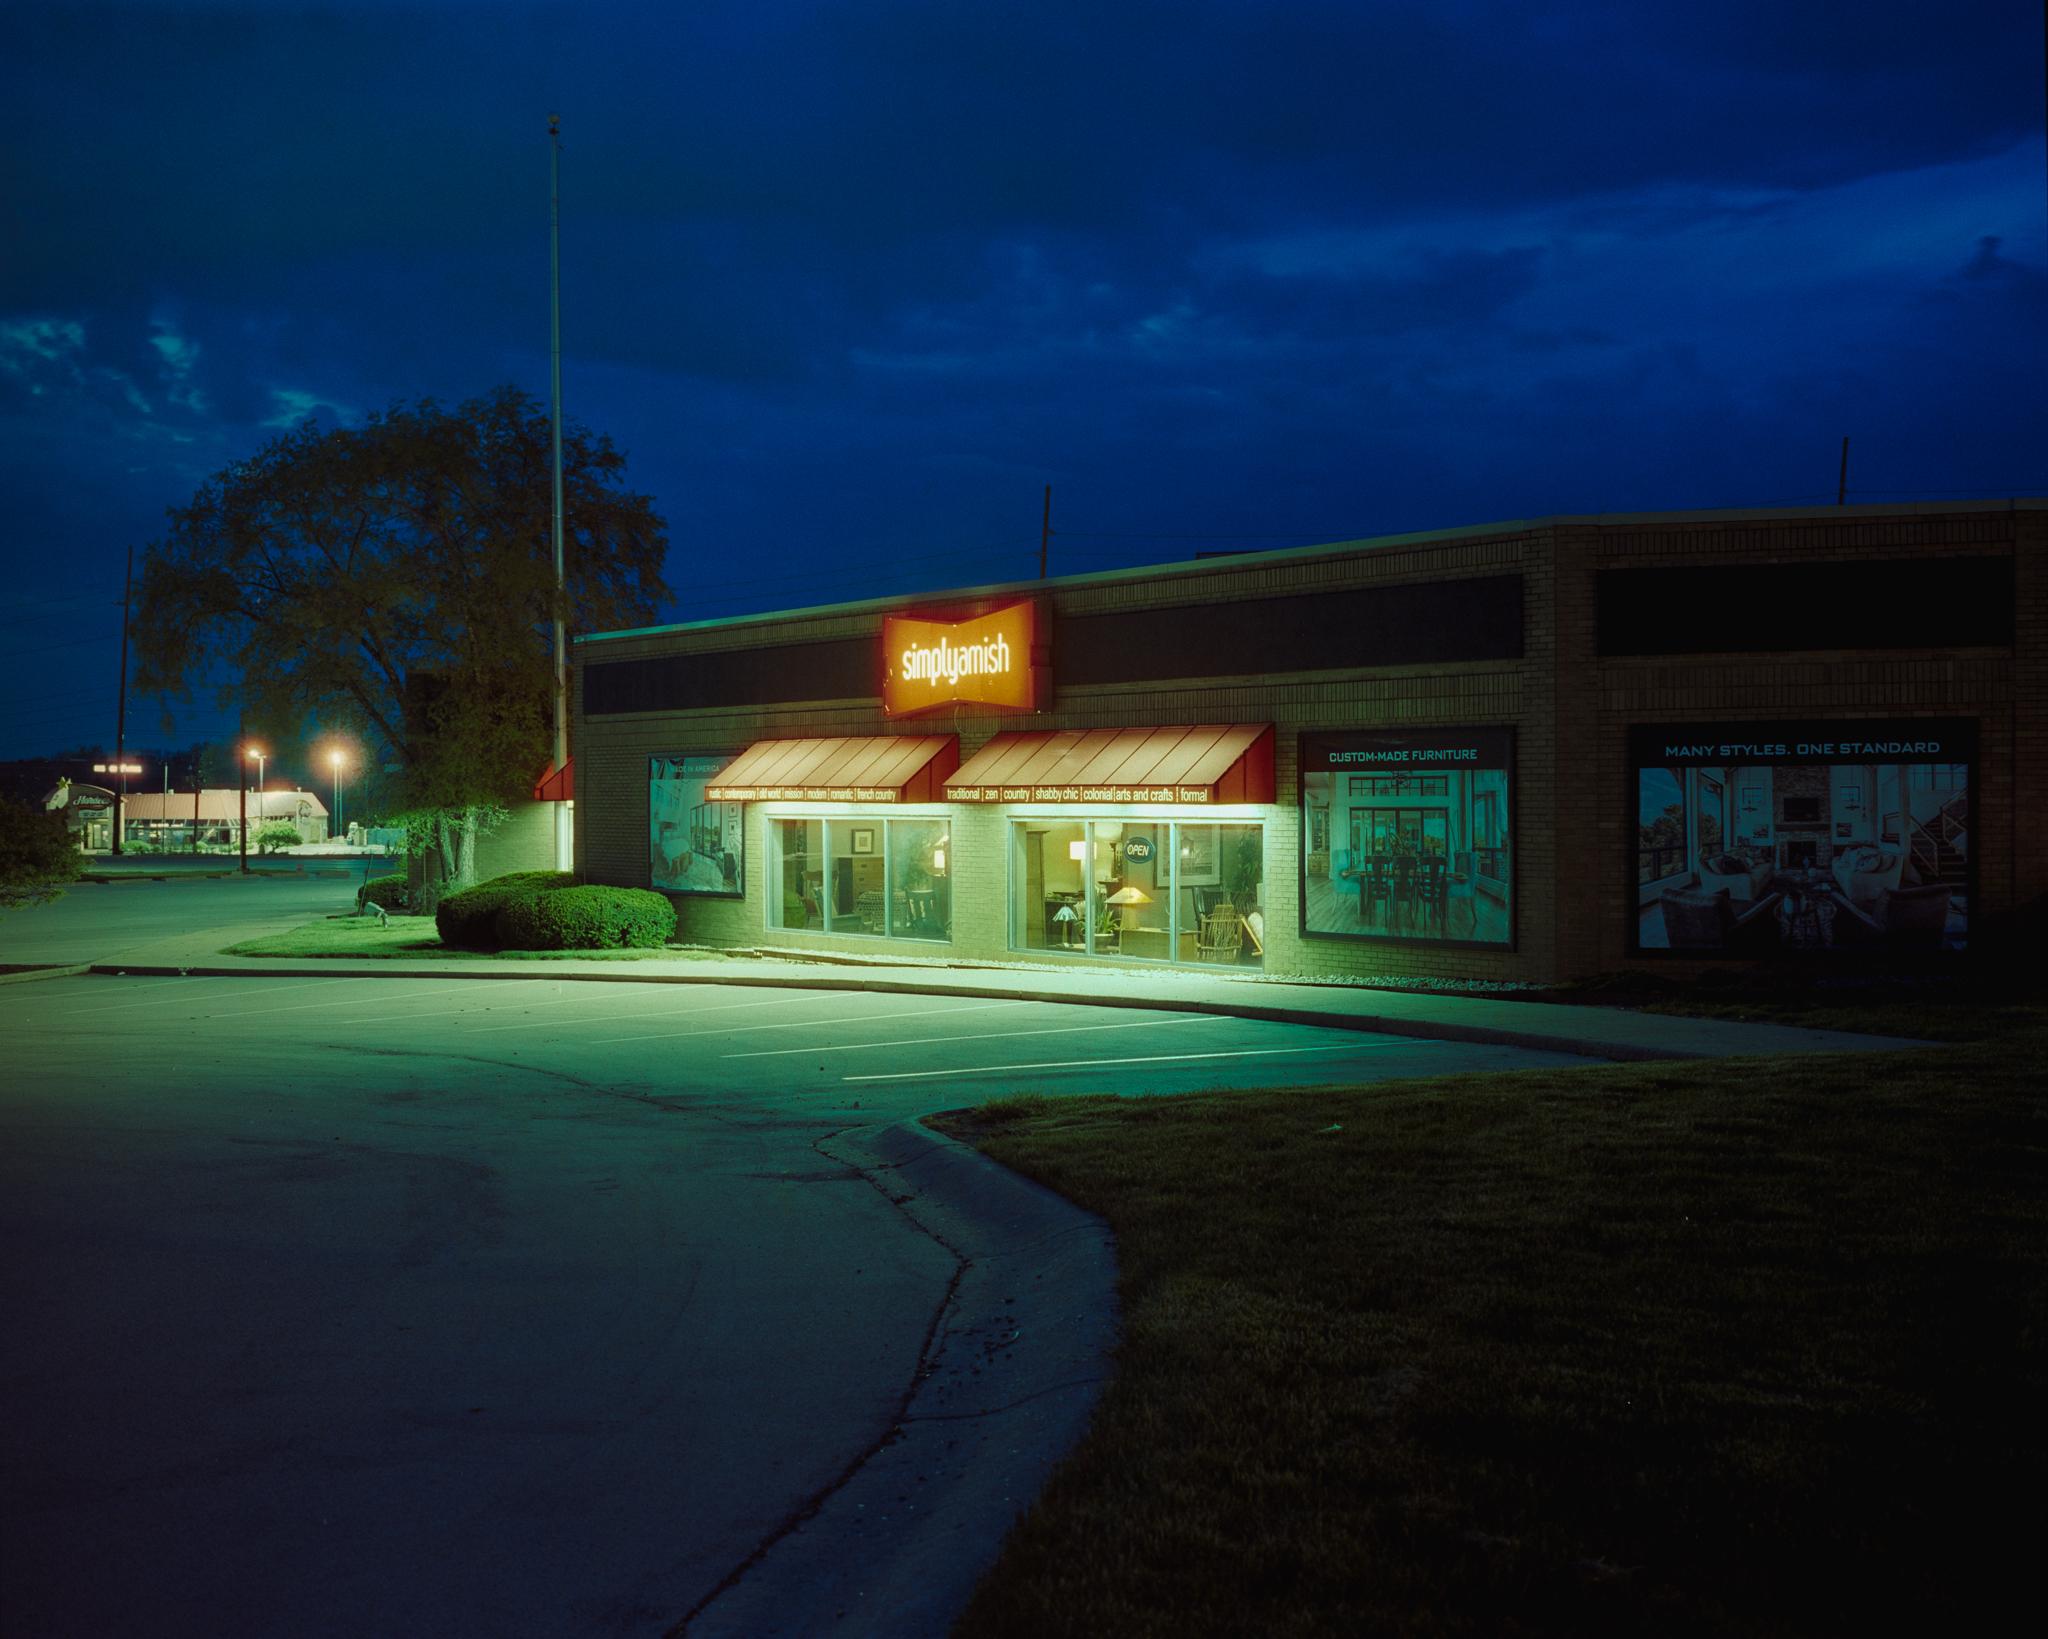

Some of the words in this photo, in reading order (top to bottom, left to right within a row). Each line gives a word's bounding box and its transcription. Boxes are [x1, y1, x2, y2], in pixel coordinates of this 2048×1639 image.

[902, 632, 1009, 687] simplyamish
[1329, 751, 1409, 762] CUSTOM-MADE
[1412, 749, 1478, 760] FURNITURE
[1665, 745, 1714, 757] MANY
[1720, 744, 1791, 756] STYLES.
[1796, 743, 1834, 755] ONE
[1839, 742, 1940, 754] STANDARD
[695, 764, 720, 772] AMERICA
[724, 788, 756, 801] contemporary
[759, 787, 767, 799] old
[767, 787, 782, 799] world
[784, 788, 803, 800] mission
[807, 788, 827, 800] modern
[830, 788, 854, 801] romantic
[857, 788, 875, 801] french
[875, 788, 896, 803] country
[947, 787, 980, 800] traditional
[985, 789, 998, 800] zen
[1003, 788, 1030, 802] country
[1035, 788, 1063, 802] shabby
[1063, 788, 1079, 800] chic
[1083, 788, 1113, 801] colonial
[1115, 789, 1131, 801] arts
[1133, 788, 1149, 801] and
[1150, 788, 1173, 801] crafts
[1181, 788, 1207, 802] formal
[1127, 844, 1149, 857] OPEN
